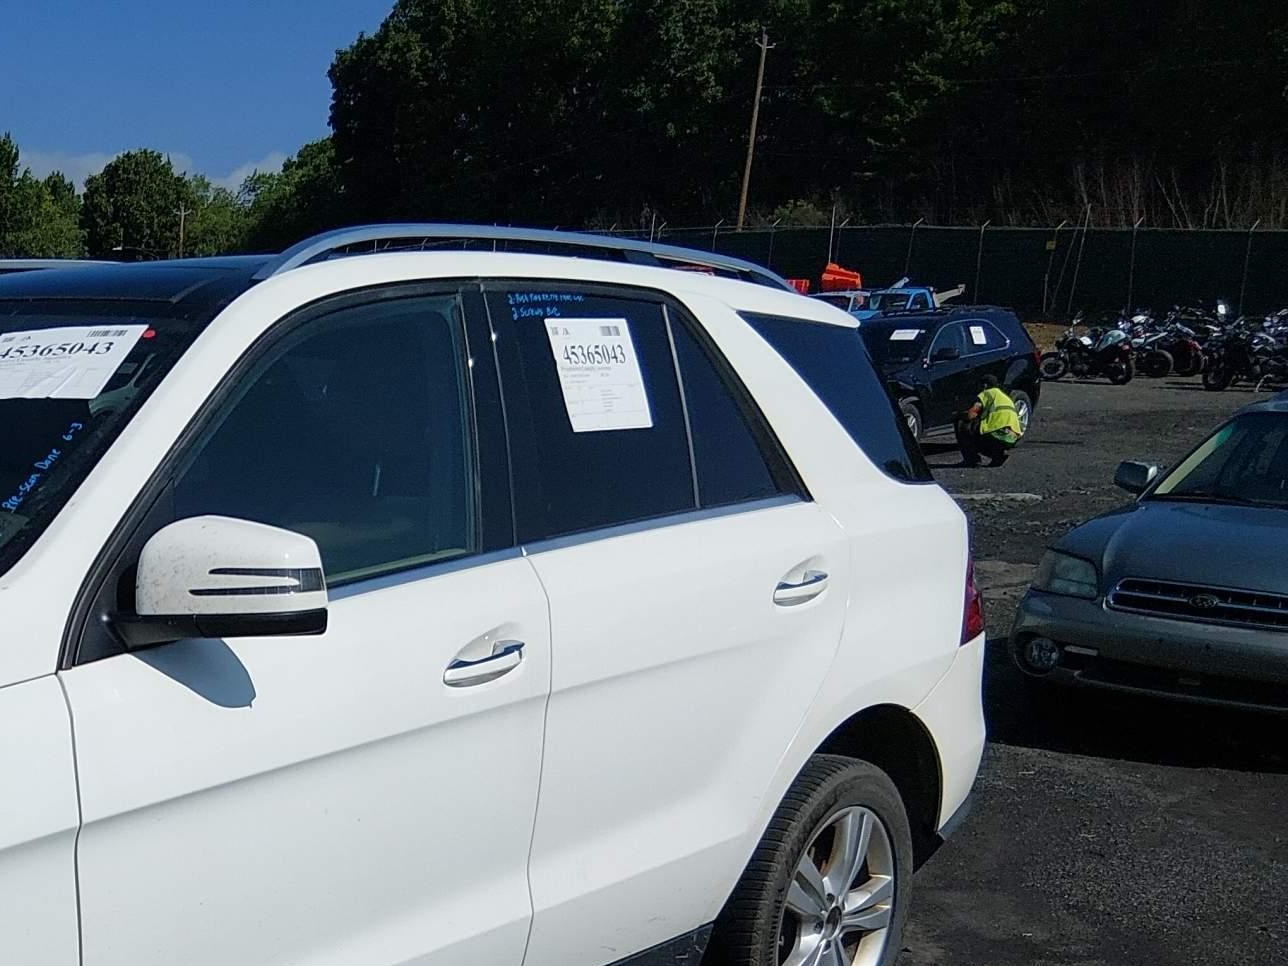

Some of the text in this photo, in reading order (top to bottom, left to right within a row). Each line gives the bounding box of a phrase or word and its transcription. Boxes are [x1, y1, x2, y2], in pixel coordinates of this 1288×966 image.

[562, 344, 626, 364] 45365043
[34, 448, 61, 470] Done
[62, 422, 83, 440] 6-3
